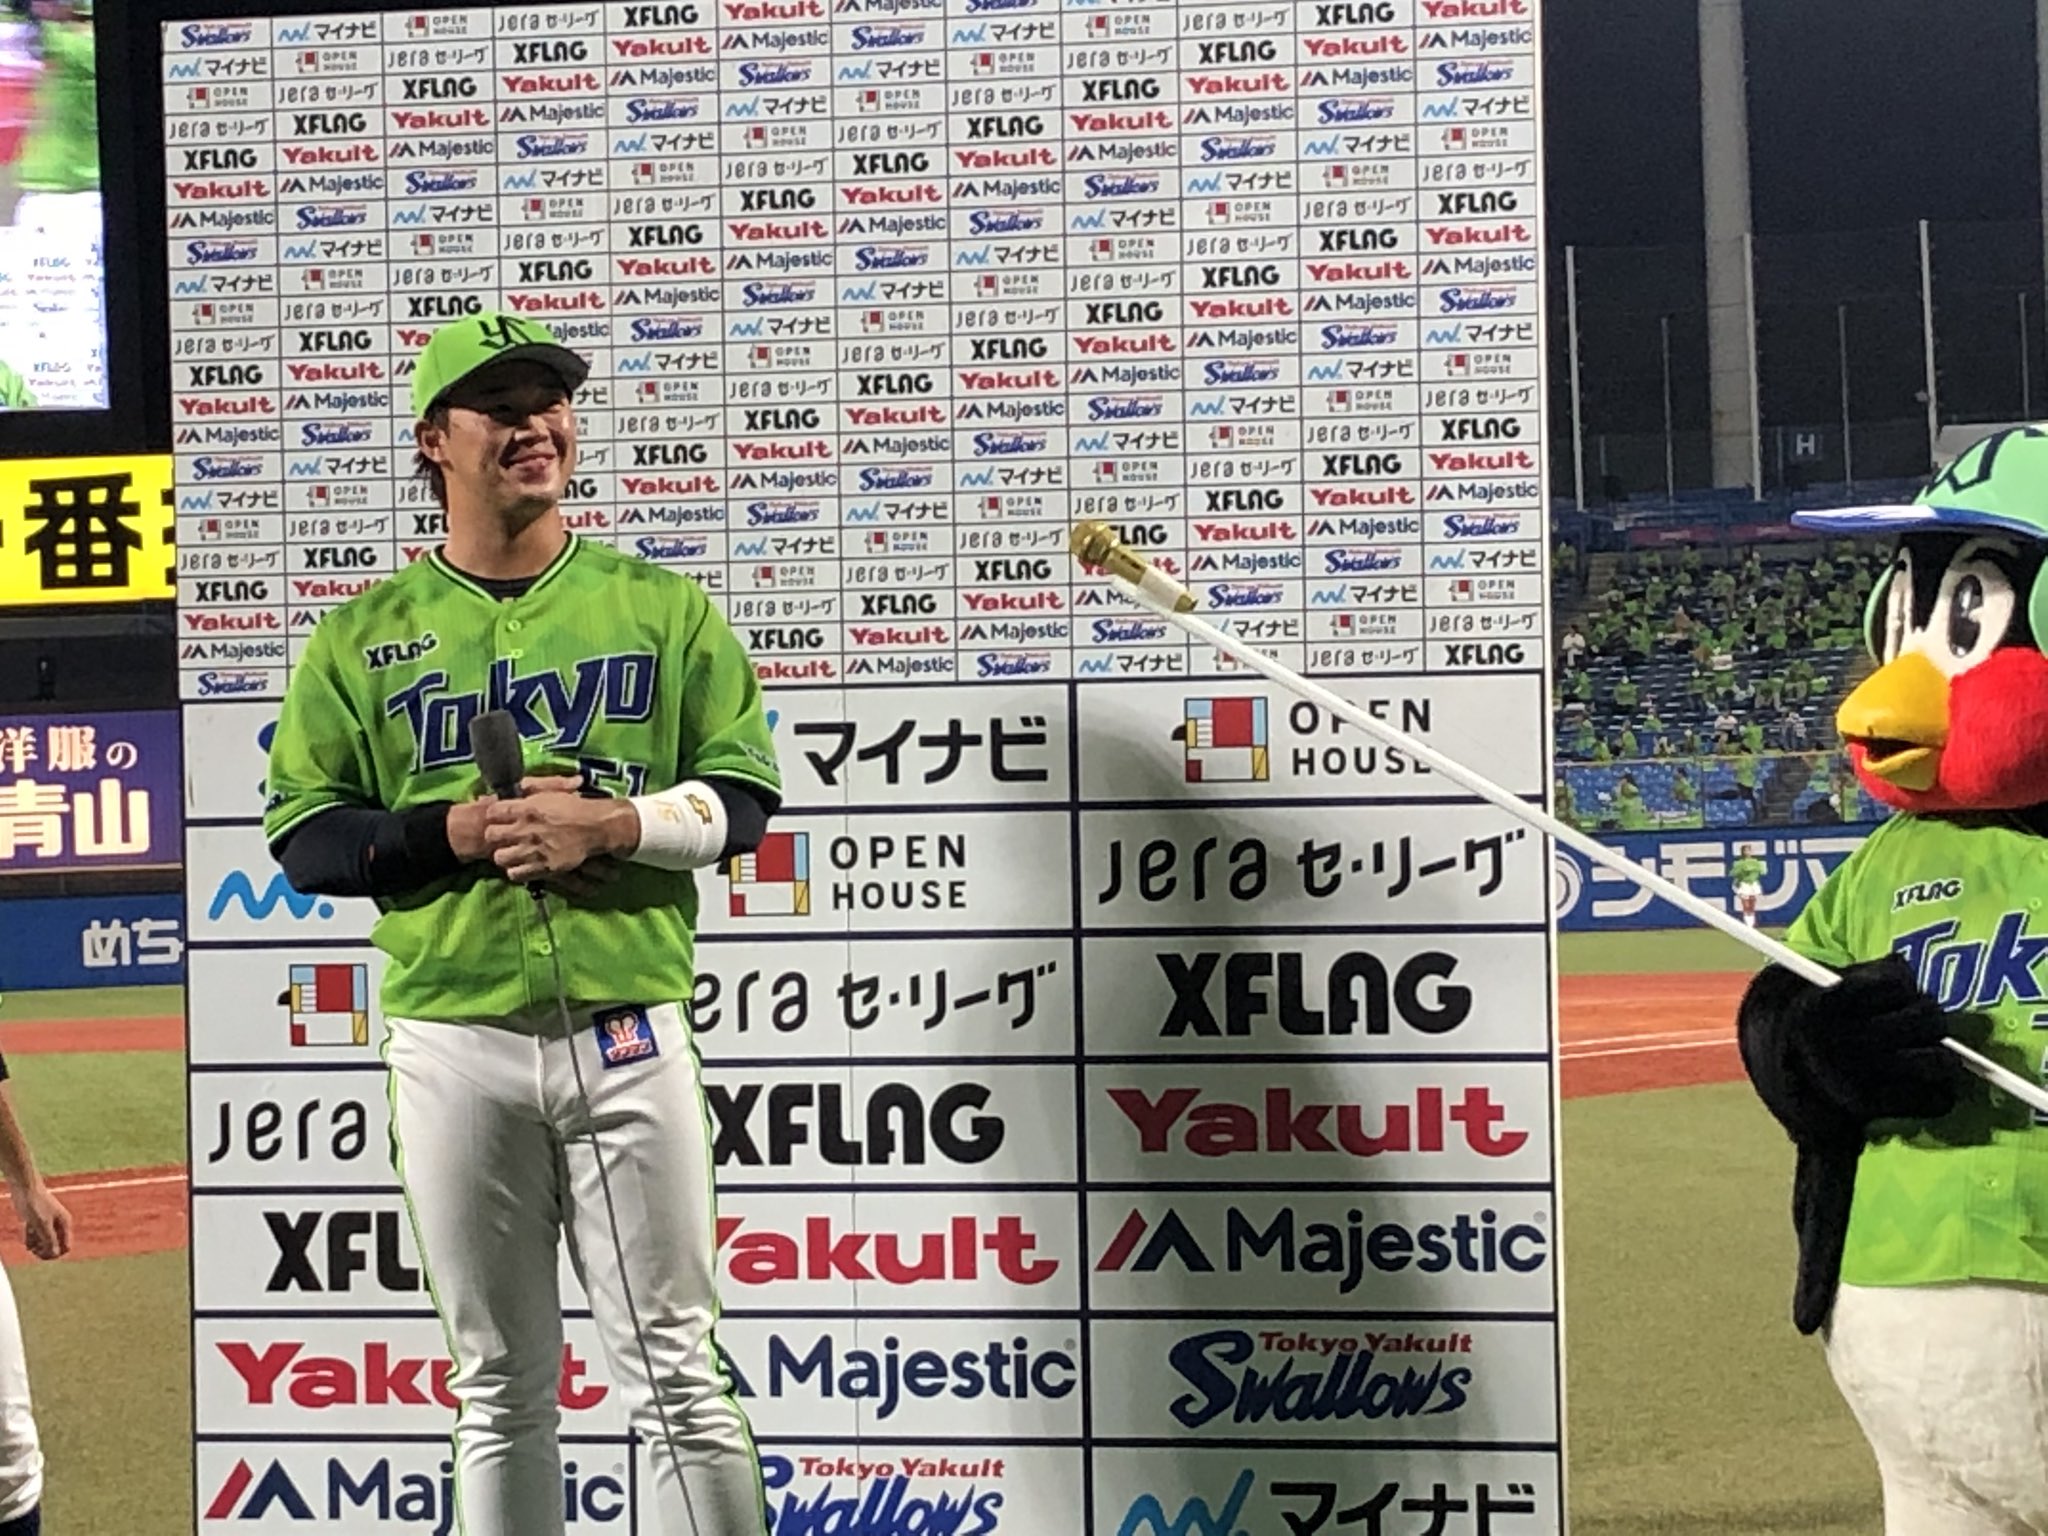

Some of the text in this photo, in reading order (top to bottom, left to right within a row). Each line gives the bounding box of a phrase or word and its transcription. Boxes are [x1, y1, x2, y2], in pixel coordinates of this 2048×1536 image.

[512, 40, 587, 62] XFLAG
[611, 36, 712, 56] Yakult
[1198, 40, 1276, 63] XFLAG
[1302, 36, 1408, 56] Yakult
[639, 65, 716, 88] Majestic
[875, 58, 940, 77] マイナビ
[1331, 65, 1412, 89] Majestic
[402, 76, 476, 99] XFLAG
[500, 73, 600, 92] Yakult
[1082, 77, 1160, 100] XFLAG
[1185, 73, 1290, 93] Yakult
[528, 101, 604, 124] Majestic
[762, 95, 826, 114] マイナビ
[1214, 103, 1294, 126] Majestic
[1461, 96, 1528, 116] マイナビ
[293, 112, 366, 134] XFLAG
[390, 109, 489, 128] Yakult
[967, 114, 1044, 137] XFLAG
[1069, 111, 1173, 131] Yakult
[185, 148, 257, 170] XFLAG
[281, 145, 379, 164] Yakult
[853, 151, 929, 173] XFLAG
[955, 147, 1057, 167] Yakult
[308, 173, 383, 196] Majestic
[539, 167, 602, 186] マイナビ
[1225, 170, 1291, 190] マイナビ
[173, 180, 270, 200] Yakult
[740, 187, 816, 210] XFLAG
[841, 184, 942, 204] Yakult
[983, 177, 1061, 200] Majestic
[428, 203, 491, 222] マイナビ
[1437, 191, 1516, 214] XFLAG
[200, 209, 274, 231] Majestic
[1109, 207, 1174, 227] マイナビ
[628, 223, 703, 245] XFLAG
[728, 220, 829, 240] Yakult
[1319, 228, 1398, 251] XFLAG
[1424, 225, 1530, 245] Yakult
[517, 259, 591, 281] XFLAG
[616, 256, 716, 275] Yakult
[755, 249, 833, 272] Majestic
[1306, 262, 1411, 281] Yakult
[210, 274, 272, 293] マイナビ
[1202, 264, 1280, 287] XFLAG
[643, 285, 720, 308] Majestic
[880, 280, 944, 299] マイナビ
[407, 294, 481, 316] XFLAG
[505, 292, 604, 311] Yakult
[1086, 301, 1163, 323] XFLAG
[1189, 298, 1294, 318] Yakult
[1335, 291, 1415, 314] Majestic
[298, 329, 371, 351] XFLAG
[1218, 327, 1298, 351] Majestic
[1464, 323, 1531, 342] マイナビ
[971, 337, 1048, 359] XFLAG
[1073, 334, 1177, 354] Yakult
[286, 362, 384, 381] Yakult
[654, 351, 718, 370] マイナビ
[189, 364, 262, 386] XFLAG
[857, 372, 933, 395] XFLAG
[959, 370, 1061, 389] Yakult
[1102, 364, 1181, 386] Majestic
[178, 397, 275, 415] Yakult
[845, 406, 947, 425] Yakult
[1229, 395, 1295, 414] マイナビ
[744, 408, 820, 430] XFLAG
[1440, 417, 1520, 440] XFLAG
[205, 425, 279, 447] Majestic
[873, 435, 950, 457] Majestic
[1797, 433, 1815, 455] H
[632, 443, 707, 465] XFLAG
[732, 441, 833, 460] Yakult
[1427, 451, 1533, 471] Yakult
[324, 456, 385, 474] マイナビ
[1322, 453, 1401, 475] XFLAG
[620, 476, 720, 495] Yakult
[760, 470, 837, 492] Majestic
[998, 466, 1063, 485] マイナビ
[215, 490, 277, 508] マイナビ
[1205, 489, 1284, 511] XFLAG
[1310, 487, 1415, 506] Yakult
[1456, 481, 1537, 504] Majestic
[1193, 522, 1297, 541] Yakult
[1338, 516, 1419, 539] Majestic
[771, 536, 834, 555] マイナビ
[302, 546, 376, 568] XFLAG
[1468, 549, 1535, 568] マイナビ
[975, 559, 1052, 581] XFLAG
[194, 580, 267, 601] XFLAG
[963, 592, 1065, 611] Yakult
[861, 593, 937, 615] XFLAG
[183, 612, 280, 631] Yakult
[991, 621, 1069, 644] Majestic
[1233, 619, 1299, 638] マイナビ
[748, 628, 824, 650] XFLAG
[849, 627, 951, 645] Yakult
[209, 641, 283, 662] Majestic
[366, 633, 438, 669] XFLAG
[1444, 643, 1523, 665] XFLAG
[386, 652, 658, 773] Tokyo
[0, 726, 138, 773] 洋服の
[794, 716, 1048, 786] マイナビ
[0, 778, 150, 860] 青山
[830, 834, 966, 870] OPEN
[1297, 828, 1526, 899] セ・リーグ
[832, 880, 967, 911] HOUSE
[1893, 879, 1962, 911] XFLAG
[1892, 910, 2048, 1013] Tok
[690, 961, 1057, 1034] era セ・リーグ
[1156, 951, 1473, 1037] XFLAG
[703, 1082, 1006, 1166] XFLAG
[1107, 1087, 1529, 1158] Yakult
[263, 1211, 424, 1292] XFL
[1228, 1207, 1547, 1295] Majestic
[1259, 1332, 1473, 1357] Tokyo Yakult
[769, 1334, 1077, 1421] Majestic
[1169, 1330, 1473, 1429] Swallows
[799, 1457, 1006, 1481] Tokyo Yakult
[1270, 1482, 1536, 1536] マイナビ
